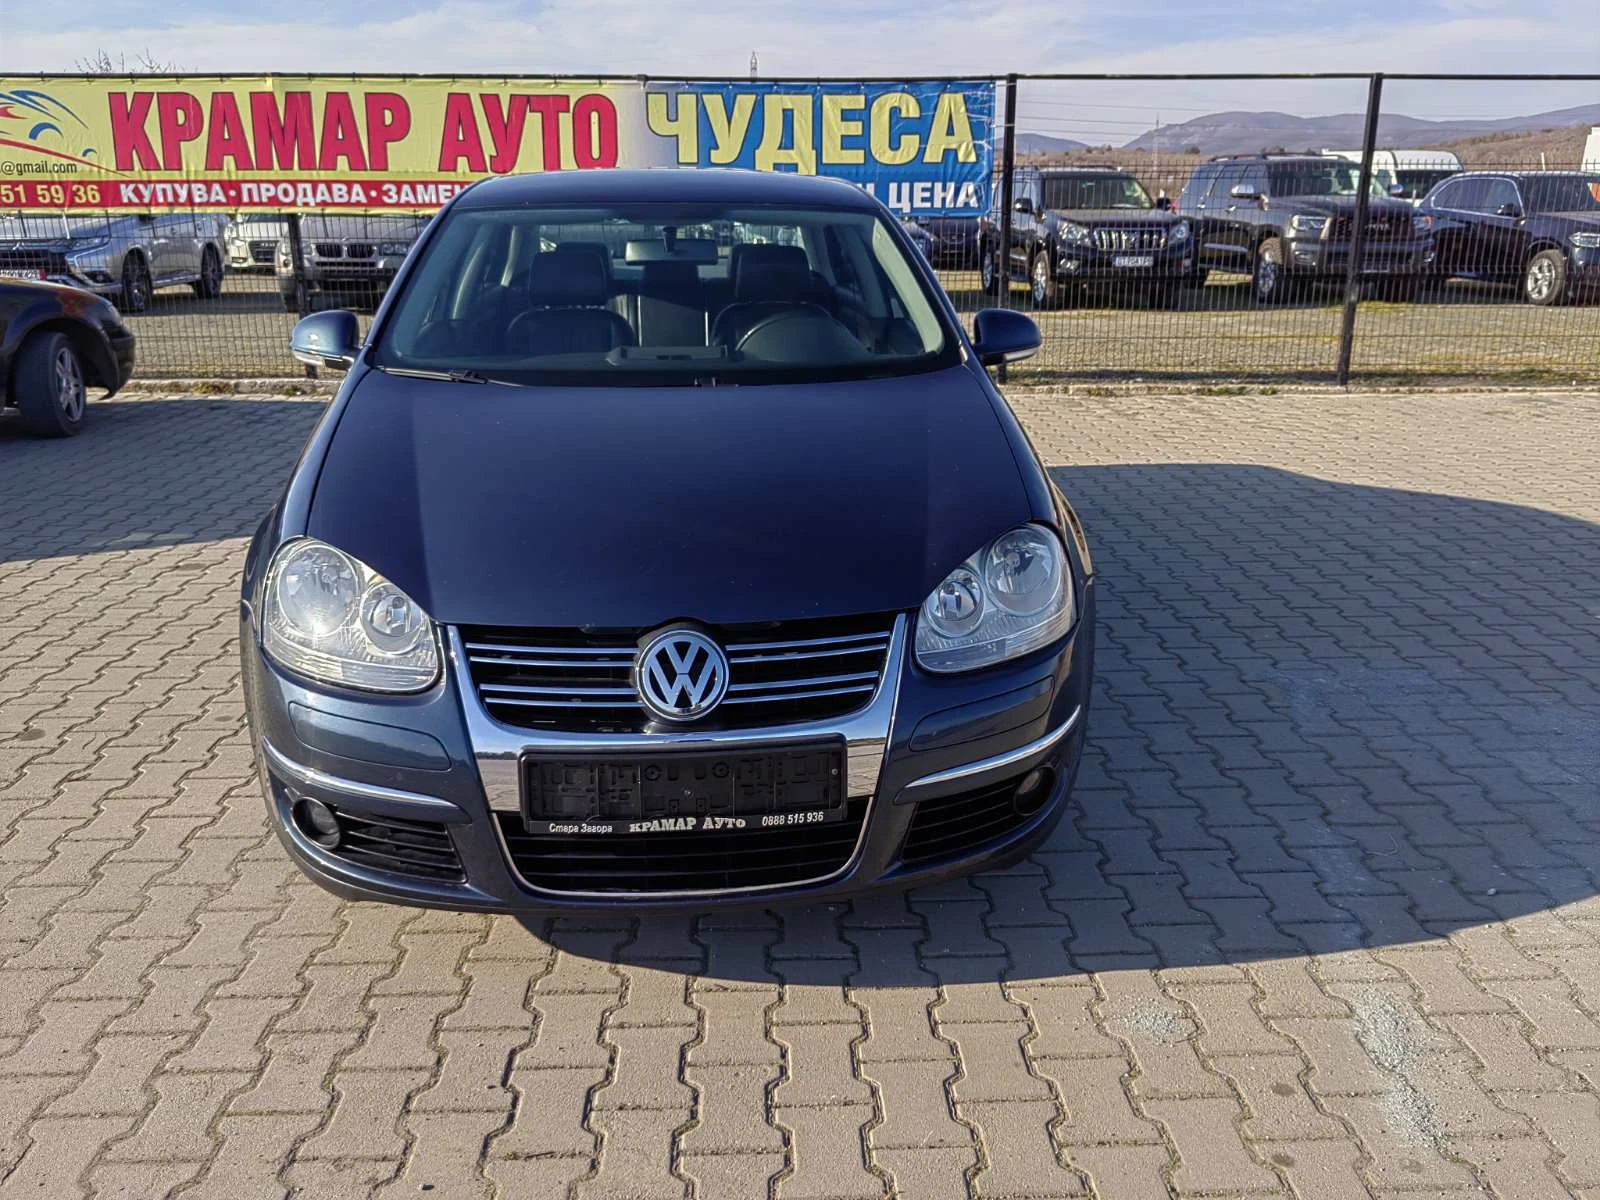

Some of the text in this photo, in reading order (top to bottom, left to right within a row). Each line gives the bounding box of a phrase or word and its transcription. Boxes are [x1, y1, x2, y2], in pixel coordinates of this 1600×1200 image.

[108, 91, 618, 174] КРАМАР АУТО
[645, 91, 978, 176] ЧУДЕСА
[0, 184, 101, 204] 51 59 36
[119, 183, 228, 204] КУПУВА
[242, 183, 367, 207] ПРОДАВА
[889, 181, 979, 213] ЦЕНА
[642, 636, 724, 716] VW
[581, 823, 613, 835] Загора
[629, 817, 697, 833] КРАМАР
[761, 811, 824, 827] 0888 515 936
